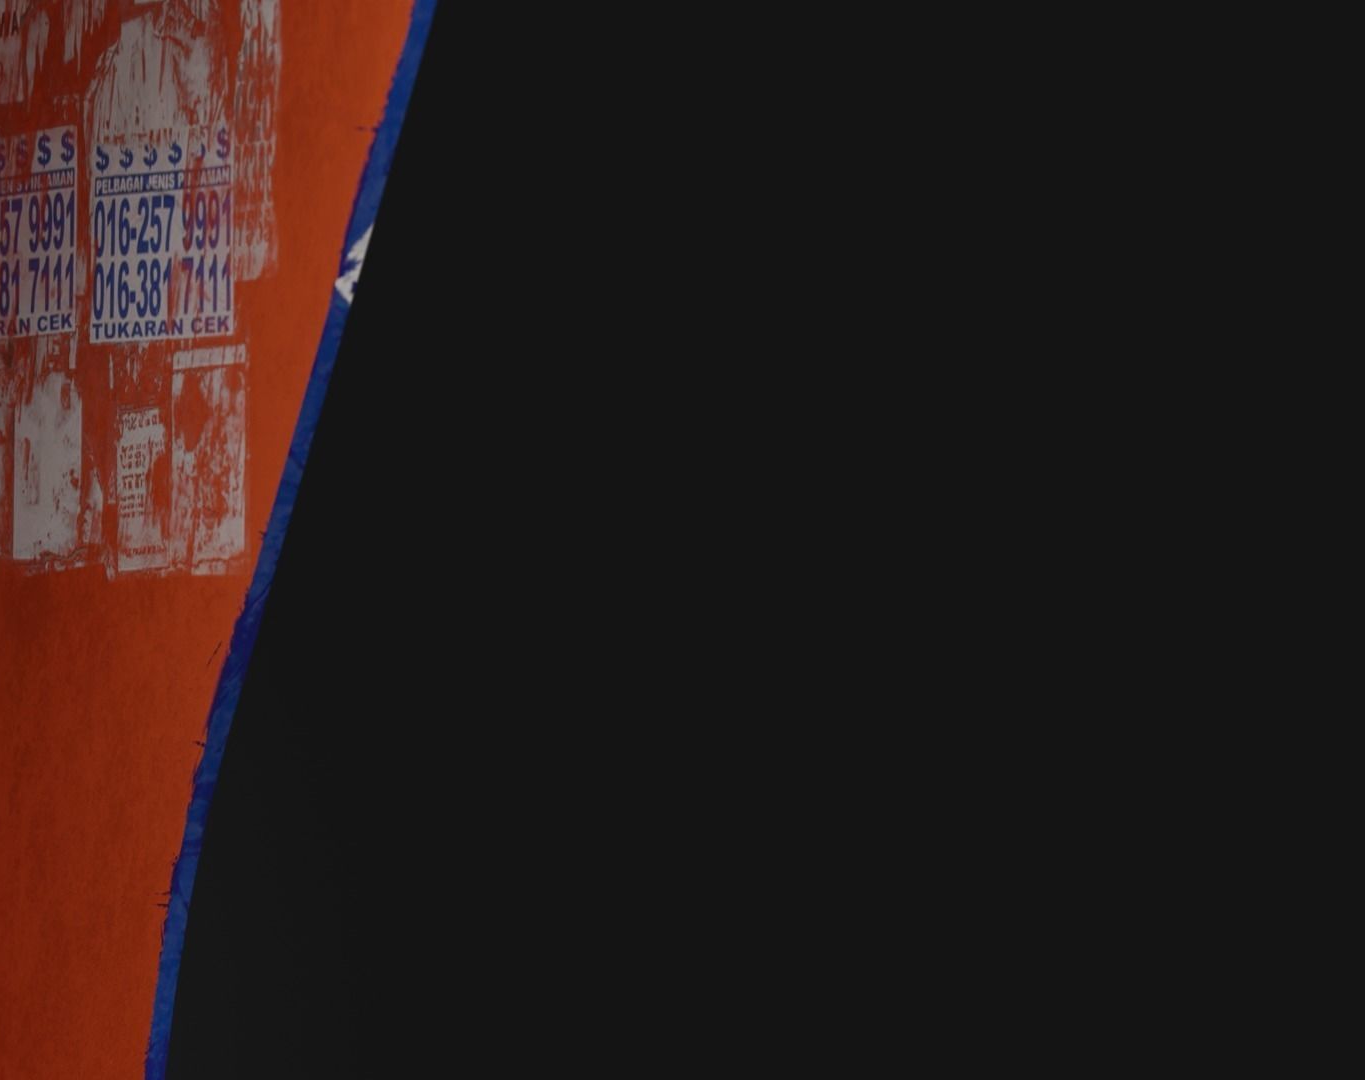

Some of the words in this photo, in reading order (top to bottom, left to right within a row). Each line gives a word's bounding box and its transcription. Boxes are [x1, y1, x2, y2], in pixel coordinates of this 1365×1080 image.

[25, 170, 74, 191] INAMAN
[96, 177, 143, 195] PELBAGAI
[146, 174, 175, 191] JENIS
[177, 167, 230, 189] PIAMAN
[28, 189, 75, 253] 9991
[94, 194, 175, 258] 016-257
[181, 189, 231, 251] 9991
[28, 253, 74, 314] 7111
[93, 257, 172, 320] 016-381
[181, 253, 231, 315] 7111
[37, 313, 73, 332] CEK
[92, 319, 183, 340] TUKARAN
[191, 315, 230, 334] CEK
